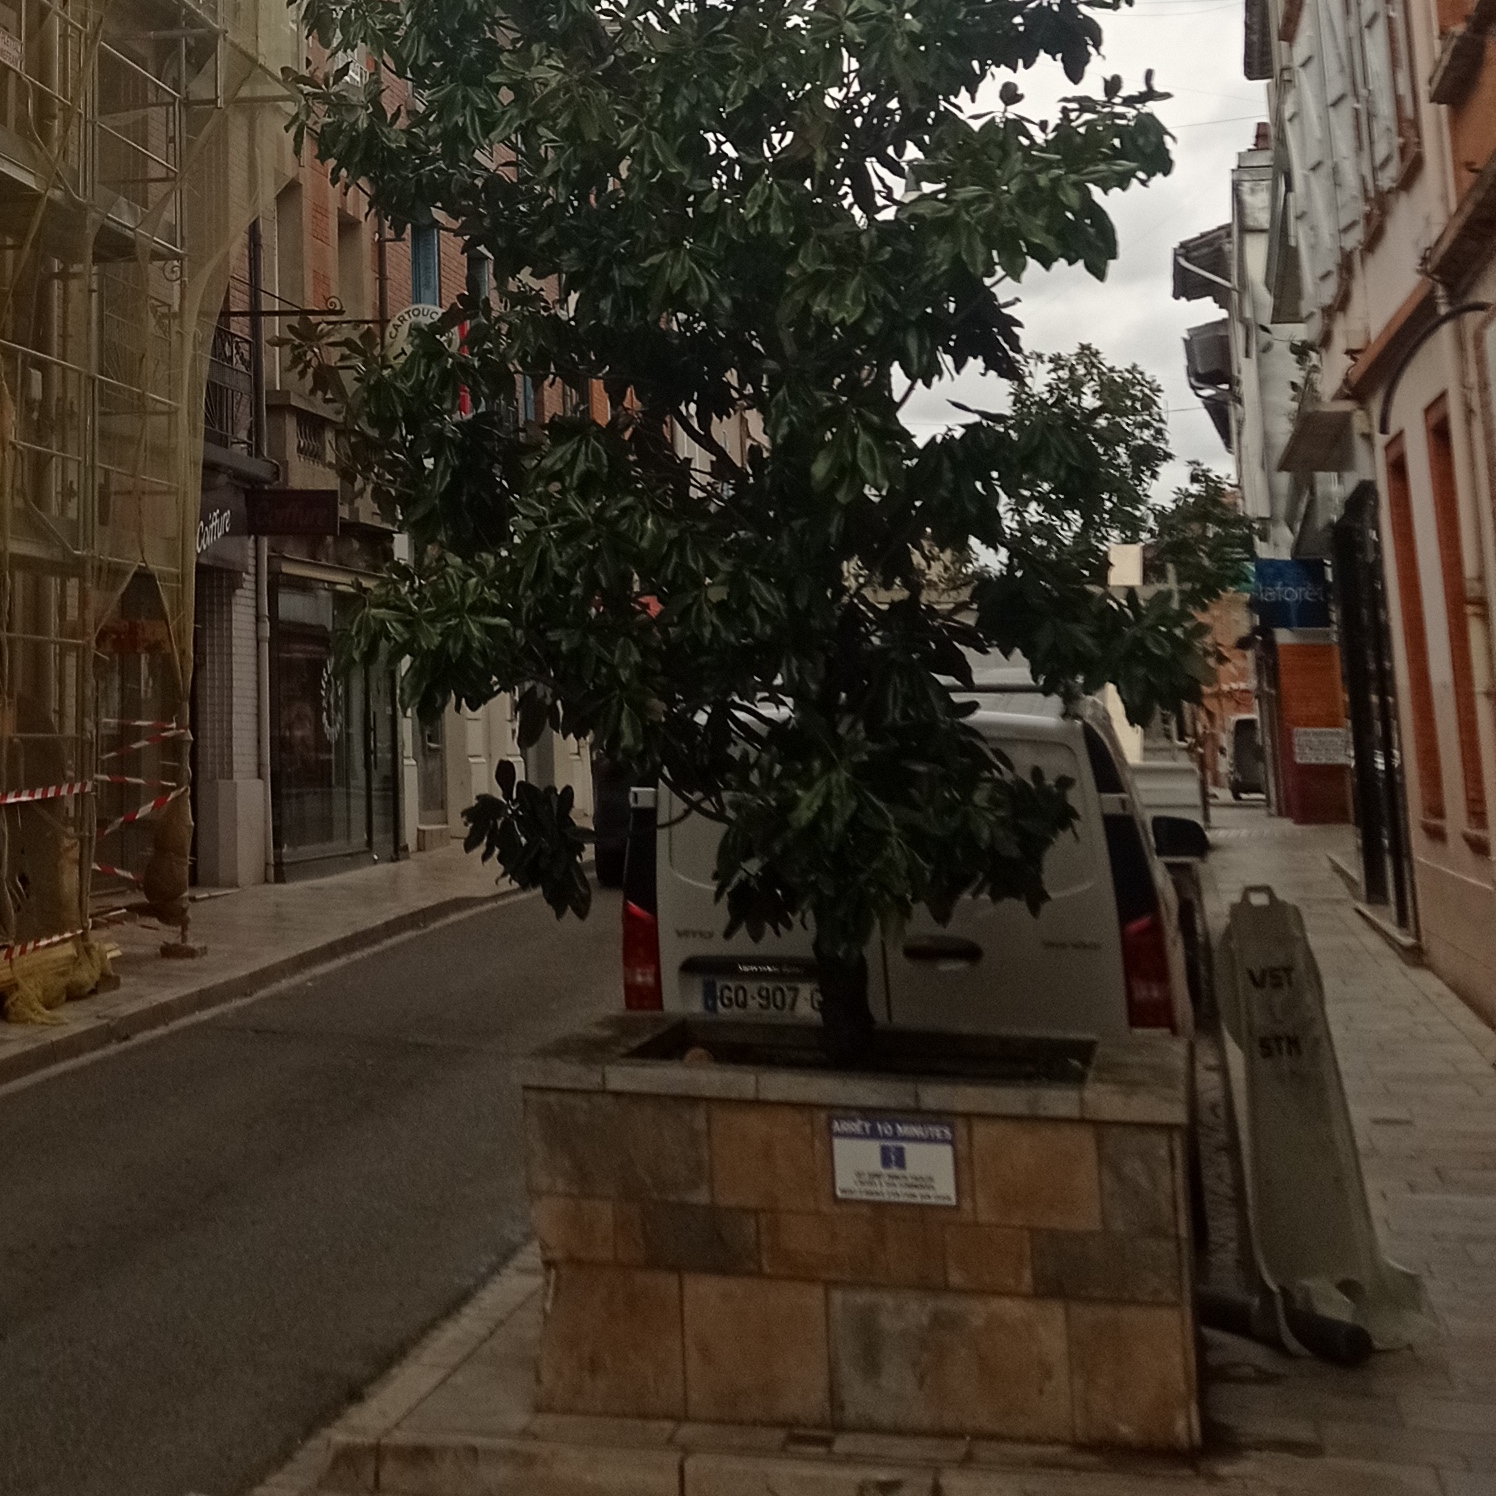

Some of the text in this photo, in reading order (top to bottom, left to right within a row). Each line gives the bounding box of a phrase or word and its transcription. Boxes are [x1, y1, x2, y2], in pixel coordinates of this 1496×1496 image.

[389, 308, 439, 340] CARTOUC
[196, 508, 231, 554] Coiffure
[876, 1120, 894, 1137] 10
[895, 1122, 953, 1141] MINUTES
